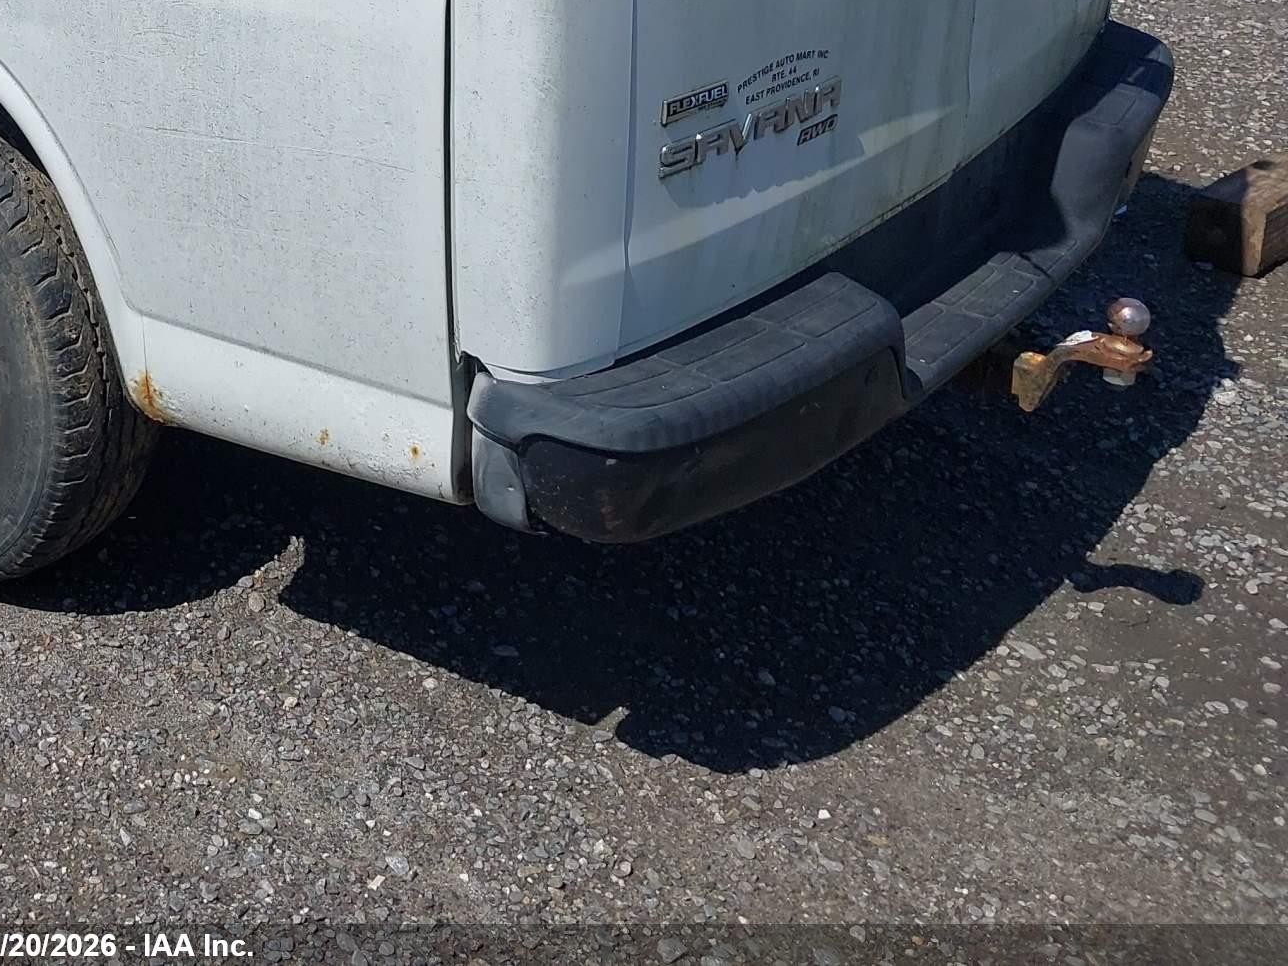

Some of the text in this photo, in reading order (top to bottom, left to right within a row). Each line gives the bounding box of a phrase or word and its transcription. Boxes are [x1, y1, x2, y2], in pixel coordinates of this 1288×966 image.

[737, 49, 829, 94] PRESTIGE AUTO MART INC
[745, 89, 765, 105] EAST
[813, 67, 820, 77] RI
[788, 65, 797, 75] 44
[660, 76, 842, 179] SAVANA
